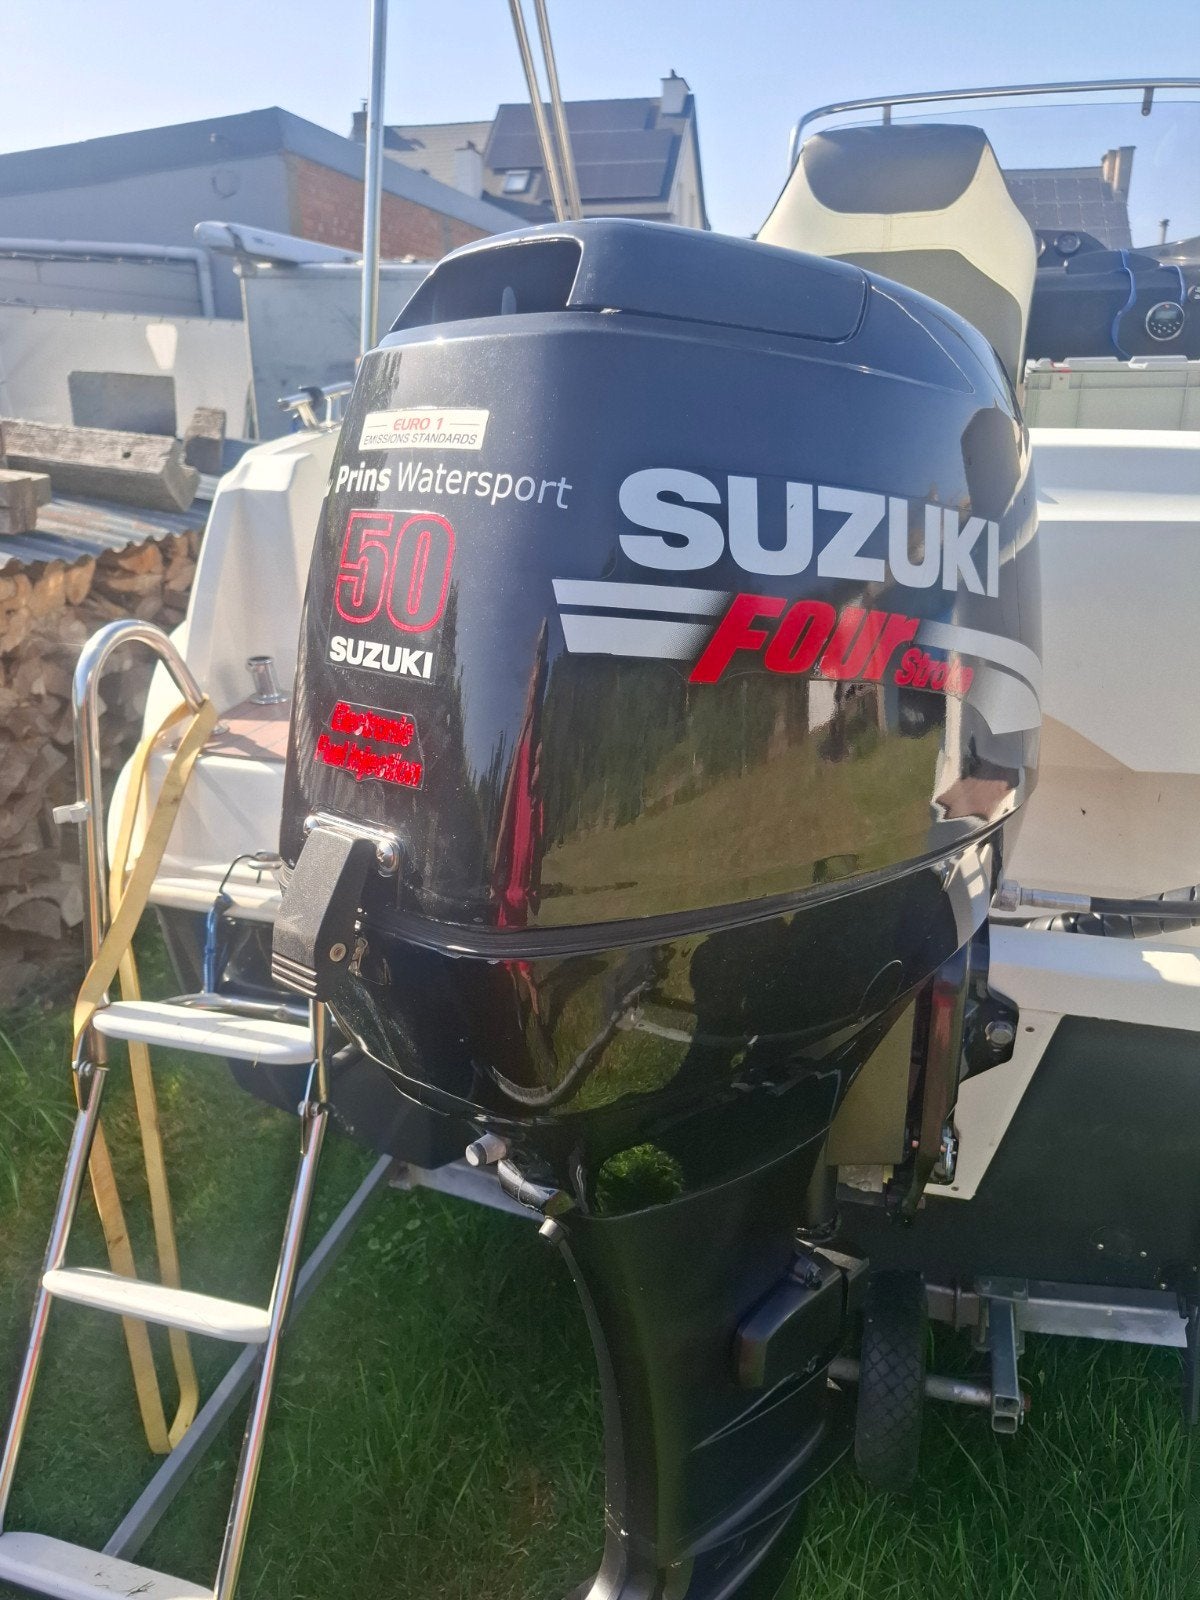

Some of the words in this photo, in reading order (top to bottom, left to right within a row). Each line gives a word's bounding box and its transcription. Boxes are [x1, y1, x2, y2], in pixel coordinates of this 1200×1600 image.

[363, 432, 410, 446] EMISSIONS
[411, 432, 478, 446] STANDARDS
[393, 417, 431, 431] EURO
[436, 417, 444, 431] 1
[334, 460, 392, 494] Prins
[397, 461, 573, 510] Watersport
[618, 467, 1000, 598] SUZUKI
[335, 512, 456, 634] 50
[329, 636, 433, 680] SUZUKI
